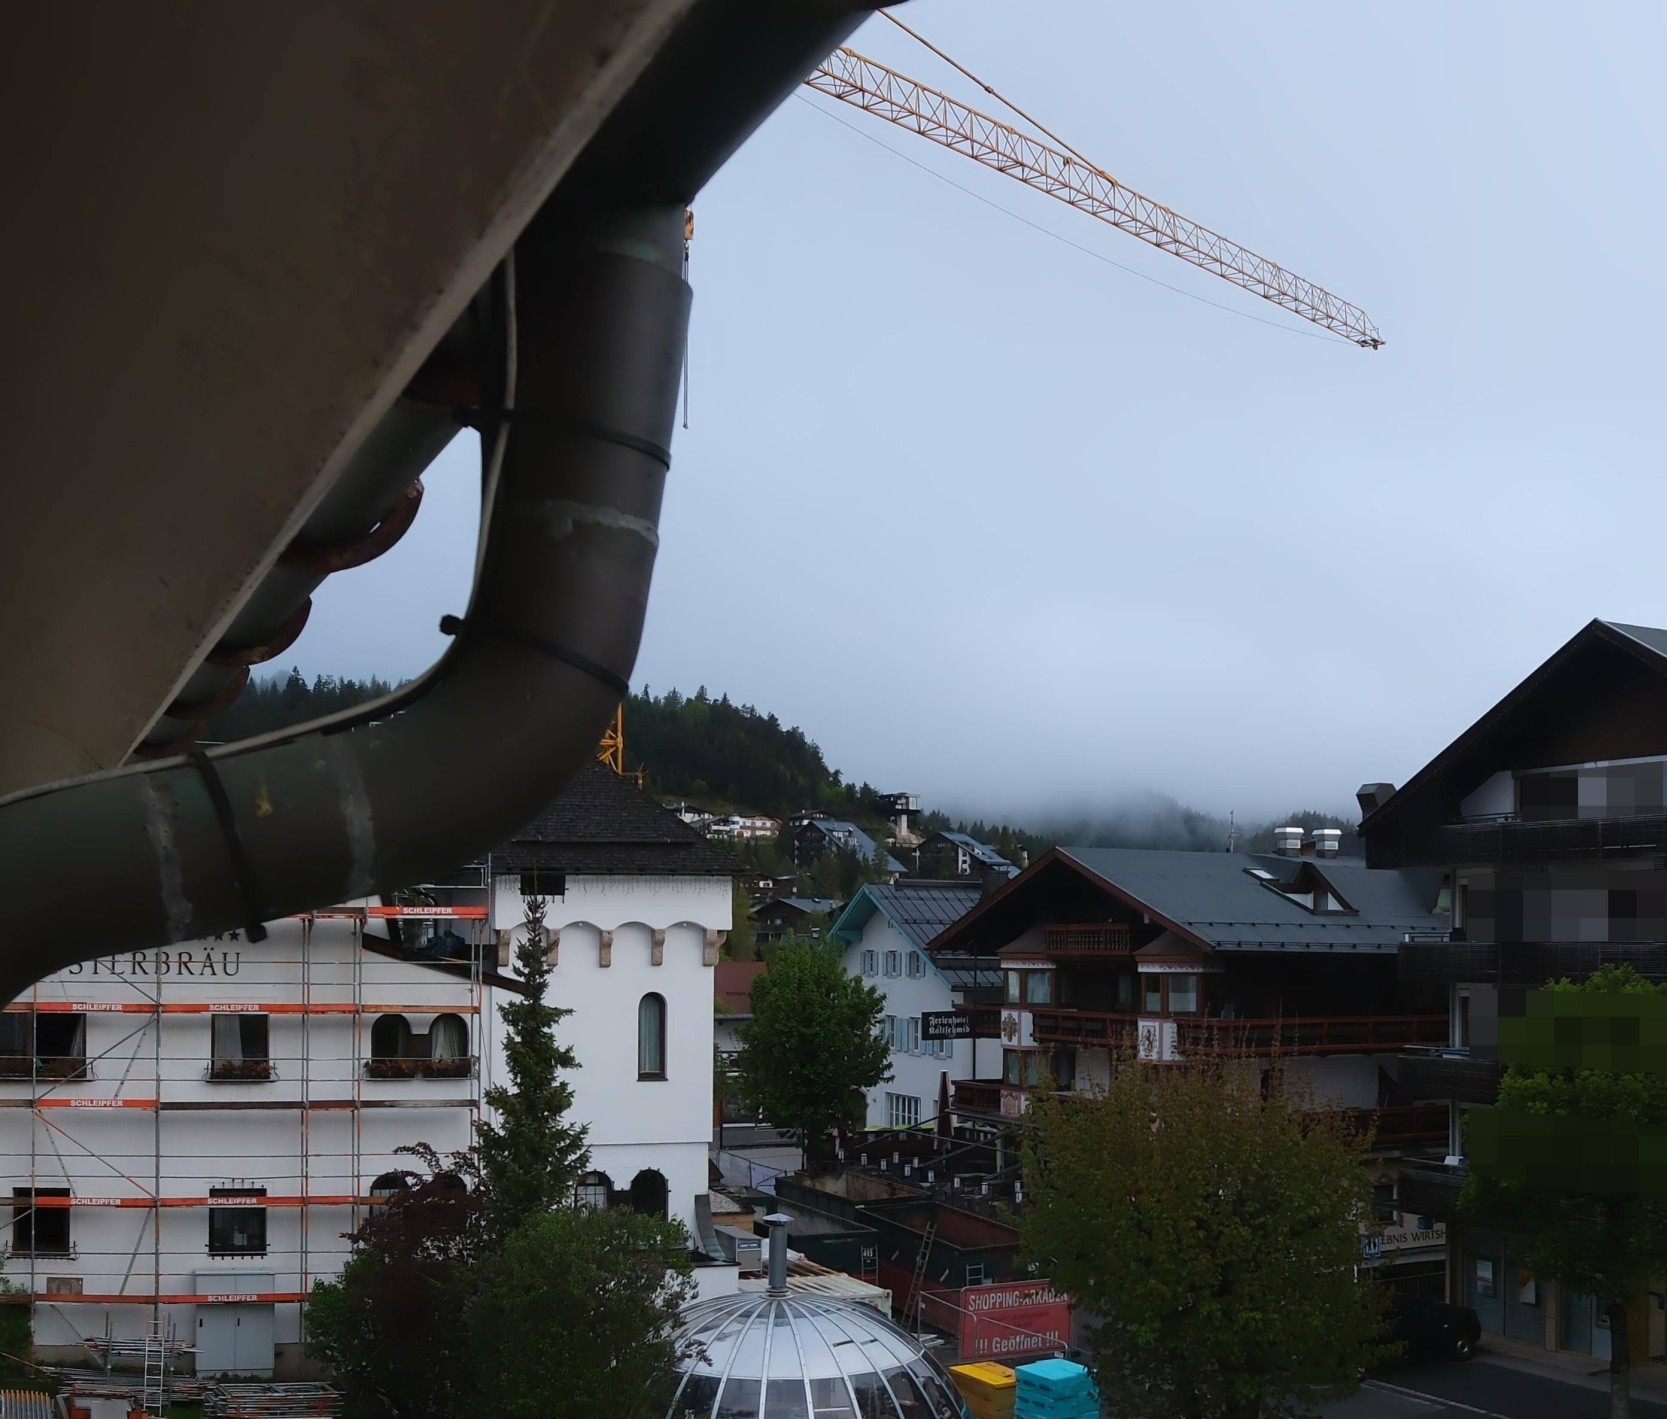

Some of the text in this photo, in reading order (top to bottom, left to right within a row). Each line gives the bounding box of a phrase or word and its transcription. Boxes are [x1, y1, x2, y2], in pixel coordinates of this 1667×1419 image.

[71, 1099, 123, 1107] SCHLEIPFER
[71, 1198, 121, 1206] SCHLEIPFER
[992, 1333, 1042, 1354] Geöffnet
